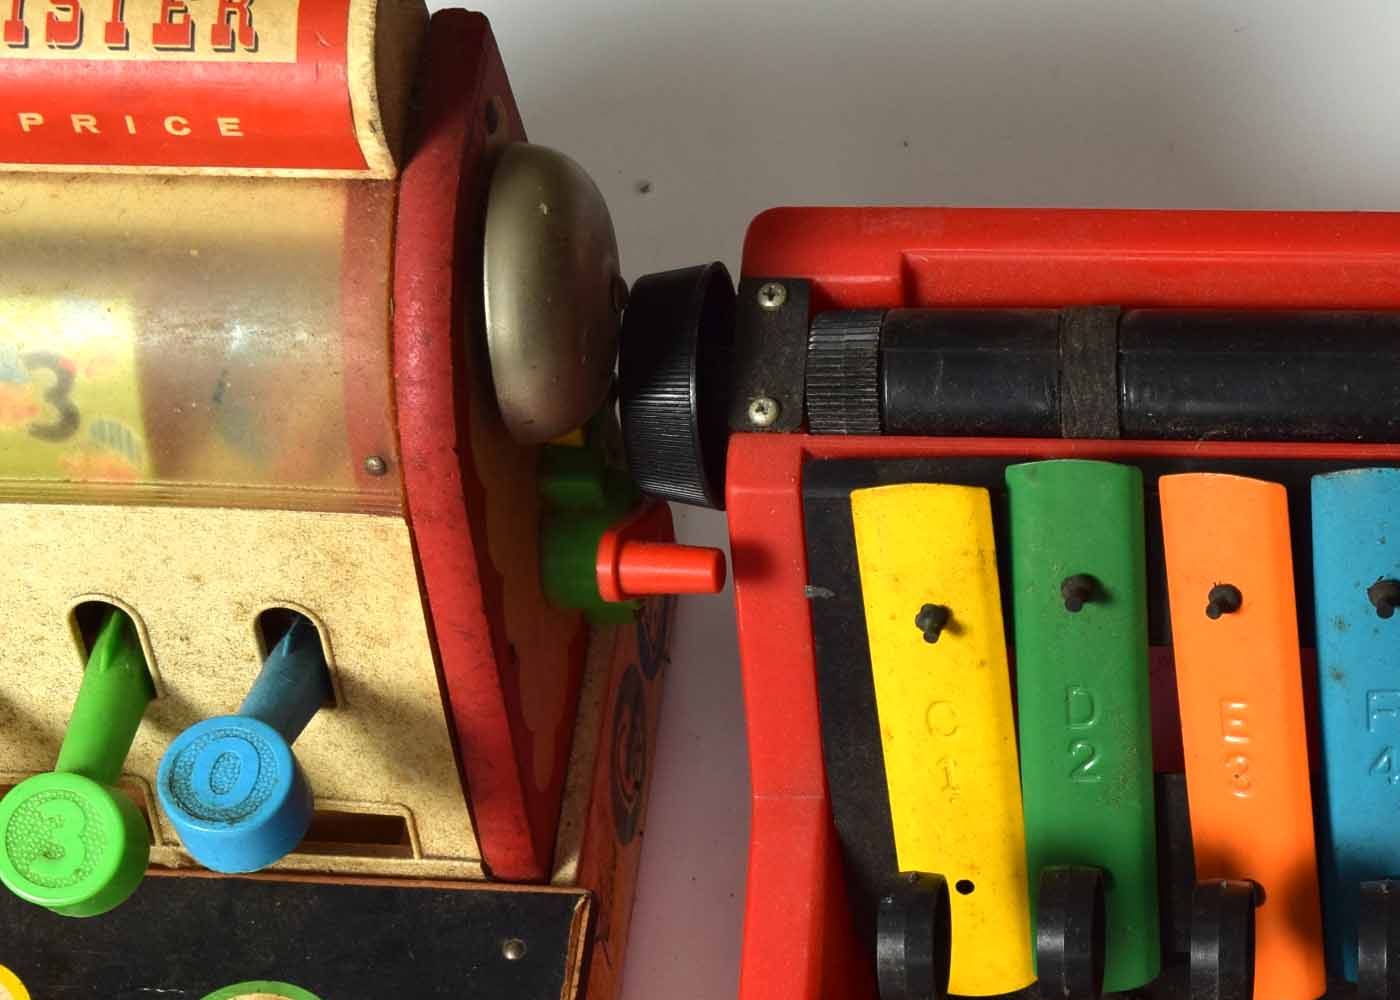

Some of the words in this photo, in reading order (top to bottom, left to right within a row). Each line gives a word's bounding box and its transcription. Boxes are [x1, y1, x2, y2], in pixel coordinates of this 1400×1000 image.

[18, 112, 244, 137] PRICE
[22, 350, 80, 442] 3
[926, 700, 959, 737] C
[1066, 686, 1097, 730] D
[190, 736, 262, 806] 0
[1068, 739, 1102, 783] 2
[29, 799, 88, 881] 3
